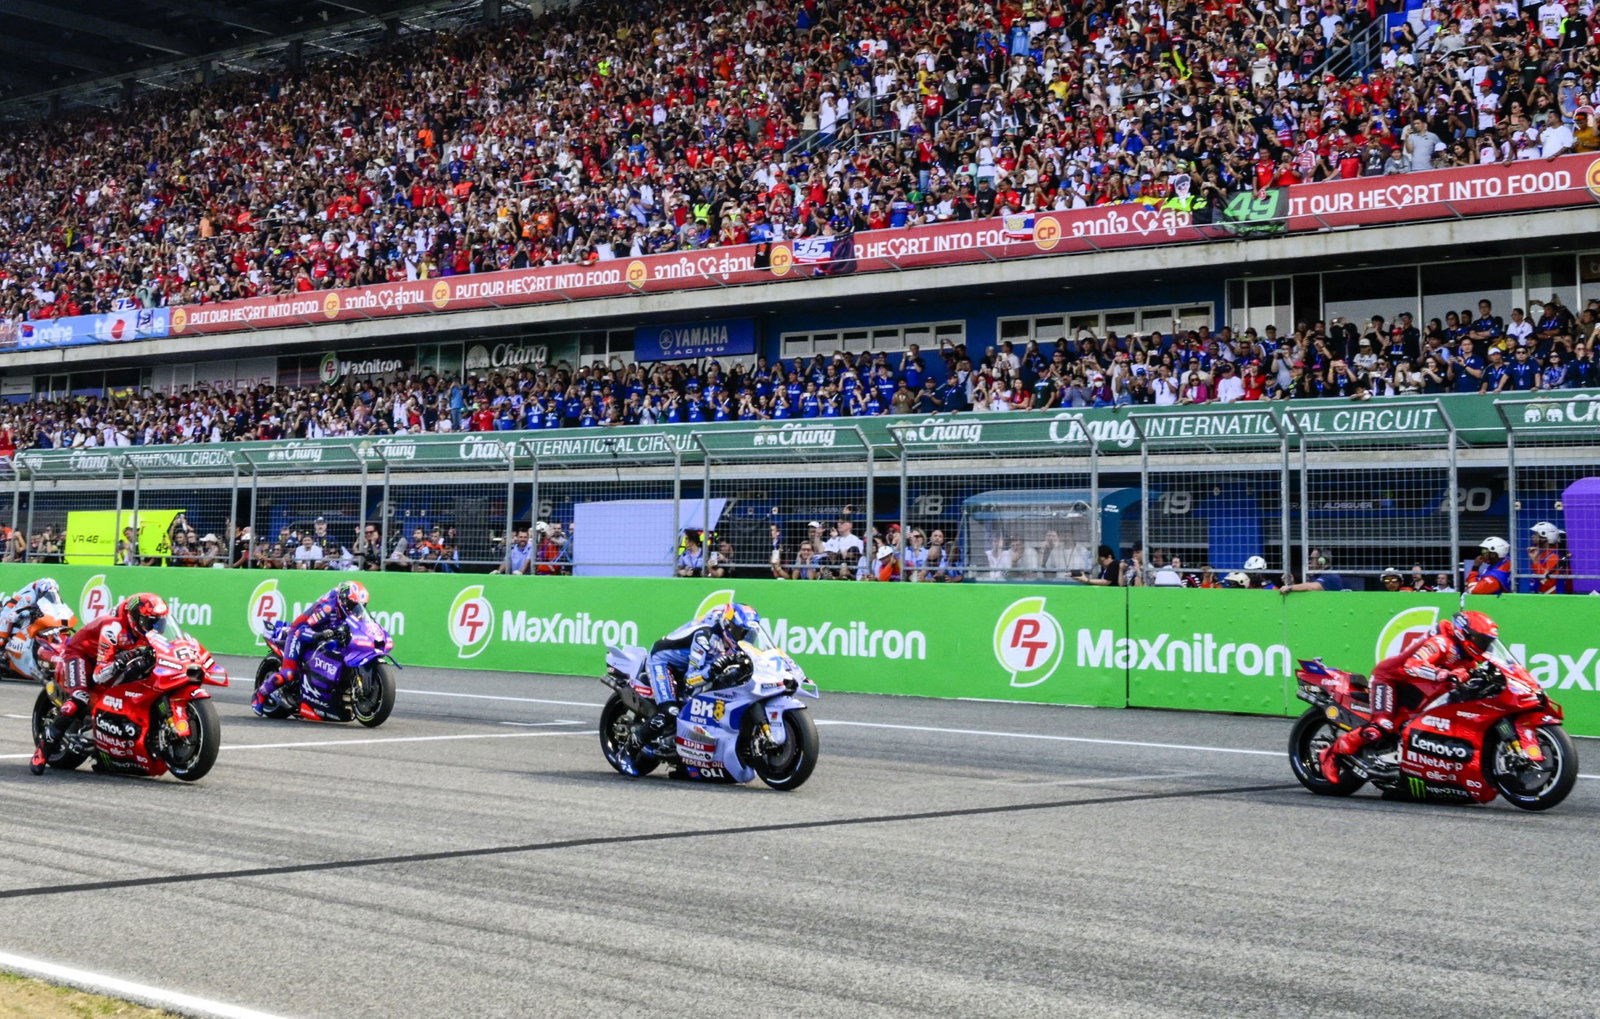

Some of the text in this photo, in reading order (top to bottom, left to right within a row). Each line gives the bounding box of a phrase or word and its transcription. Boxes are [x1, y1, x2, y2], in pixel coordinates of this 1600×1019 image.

[1310, 192, 1354, 213] OUR
[1449, 177, 1502, 201] INTO
[1508, 170, 1571, 195] FOOD
[1224, 189, 1279, 221] 49
[934, 231, 972, 252] INTO
[976, 229, 1020, 247] FOO
[456, 283, 479, 299] PUT
[480, 280, 504, 297] OUR
[555, 272, 584, 289] INTO
[586, 268, 620, 286] FOOD
[190, 311, 209, 324] PUT
[210, 309, 229, 322] OUR
[268, 303, 290, 317] INTO
[292, 300, 319, 314] FOOD
[673, 326, 728, 348] YAMAHA
[491, 344, 547, 369] Chang
[663, 346, 724, 356] RACING
[340, 360, 402, 376] Maxnitron
[778, 422, 836, 447] Chang
[918, 418, 983, 443] Chang
[1050, 408, 1438, 448] Chang INTERNATIONAL CIRCUIT
[459, 436, 516, 460] Chang
[637, 433, 702, 452] CIRCUIT
[912, 495, 944, 516] 18
[1159, 491, 1193, 515] 19
[1439, 487, 1492, 512] 20
[459, 603, 638, 647] PT Maxnitron
[759, 618, 926, 660] Maxnitron
[1010, 618, 1292, 677] PT Maxnitron
[1411, 734, 1467, 758] Lenovo
[1419, 753, 1464, 772] NetApp
